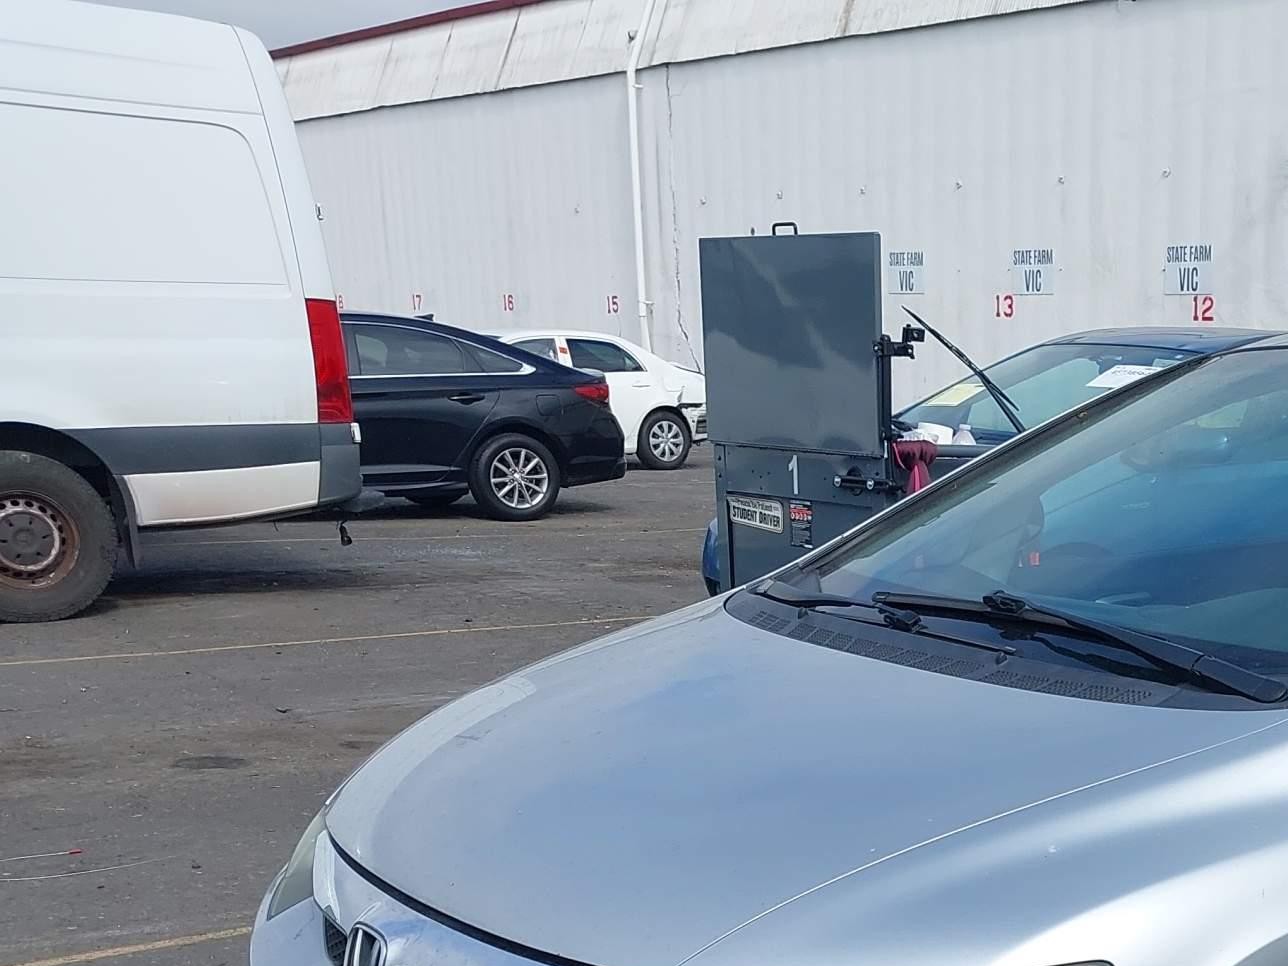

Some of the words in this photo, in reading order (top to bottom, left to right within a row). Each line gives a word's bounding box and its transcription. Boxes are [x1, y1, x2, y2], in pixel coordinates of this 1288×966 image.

[889, 252, 905, 266] STATE
[906, 251, 924, 266] FARM
[1013, 250, 1032, 265] STATE
[1033, 249, 1053, 265] FARM
[1166, 246, 1188, 264] STATE
[1189, 245, 1212, 262] FARM
[898, 270, 914, 292] VIC
[1024, 269, 1042, 293] VIC
[1178, 267, 1199, 292] VIC
[412, 294, 422, 311] 17
[503, 294, 515, 311] 16
[606, 295, 619, 314] 15
[995, 294, 1014, 318] 13
[1192, 295, 1214, 321] 12
[788, 454, 799, 495] 1
[731, 505, 758, 523] STUDENT
[759, 510, 781, 529] DRIVER
